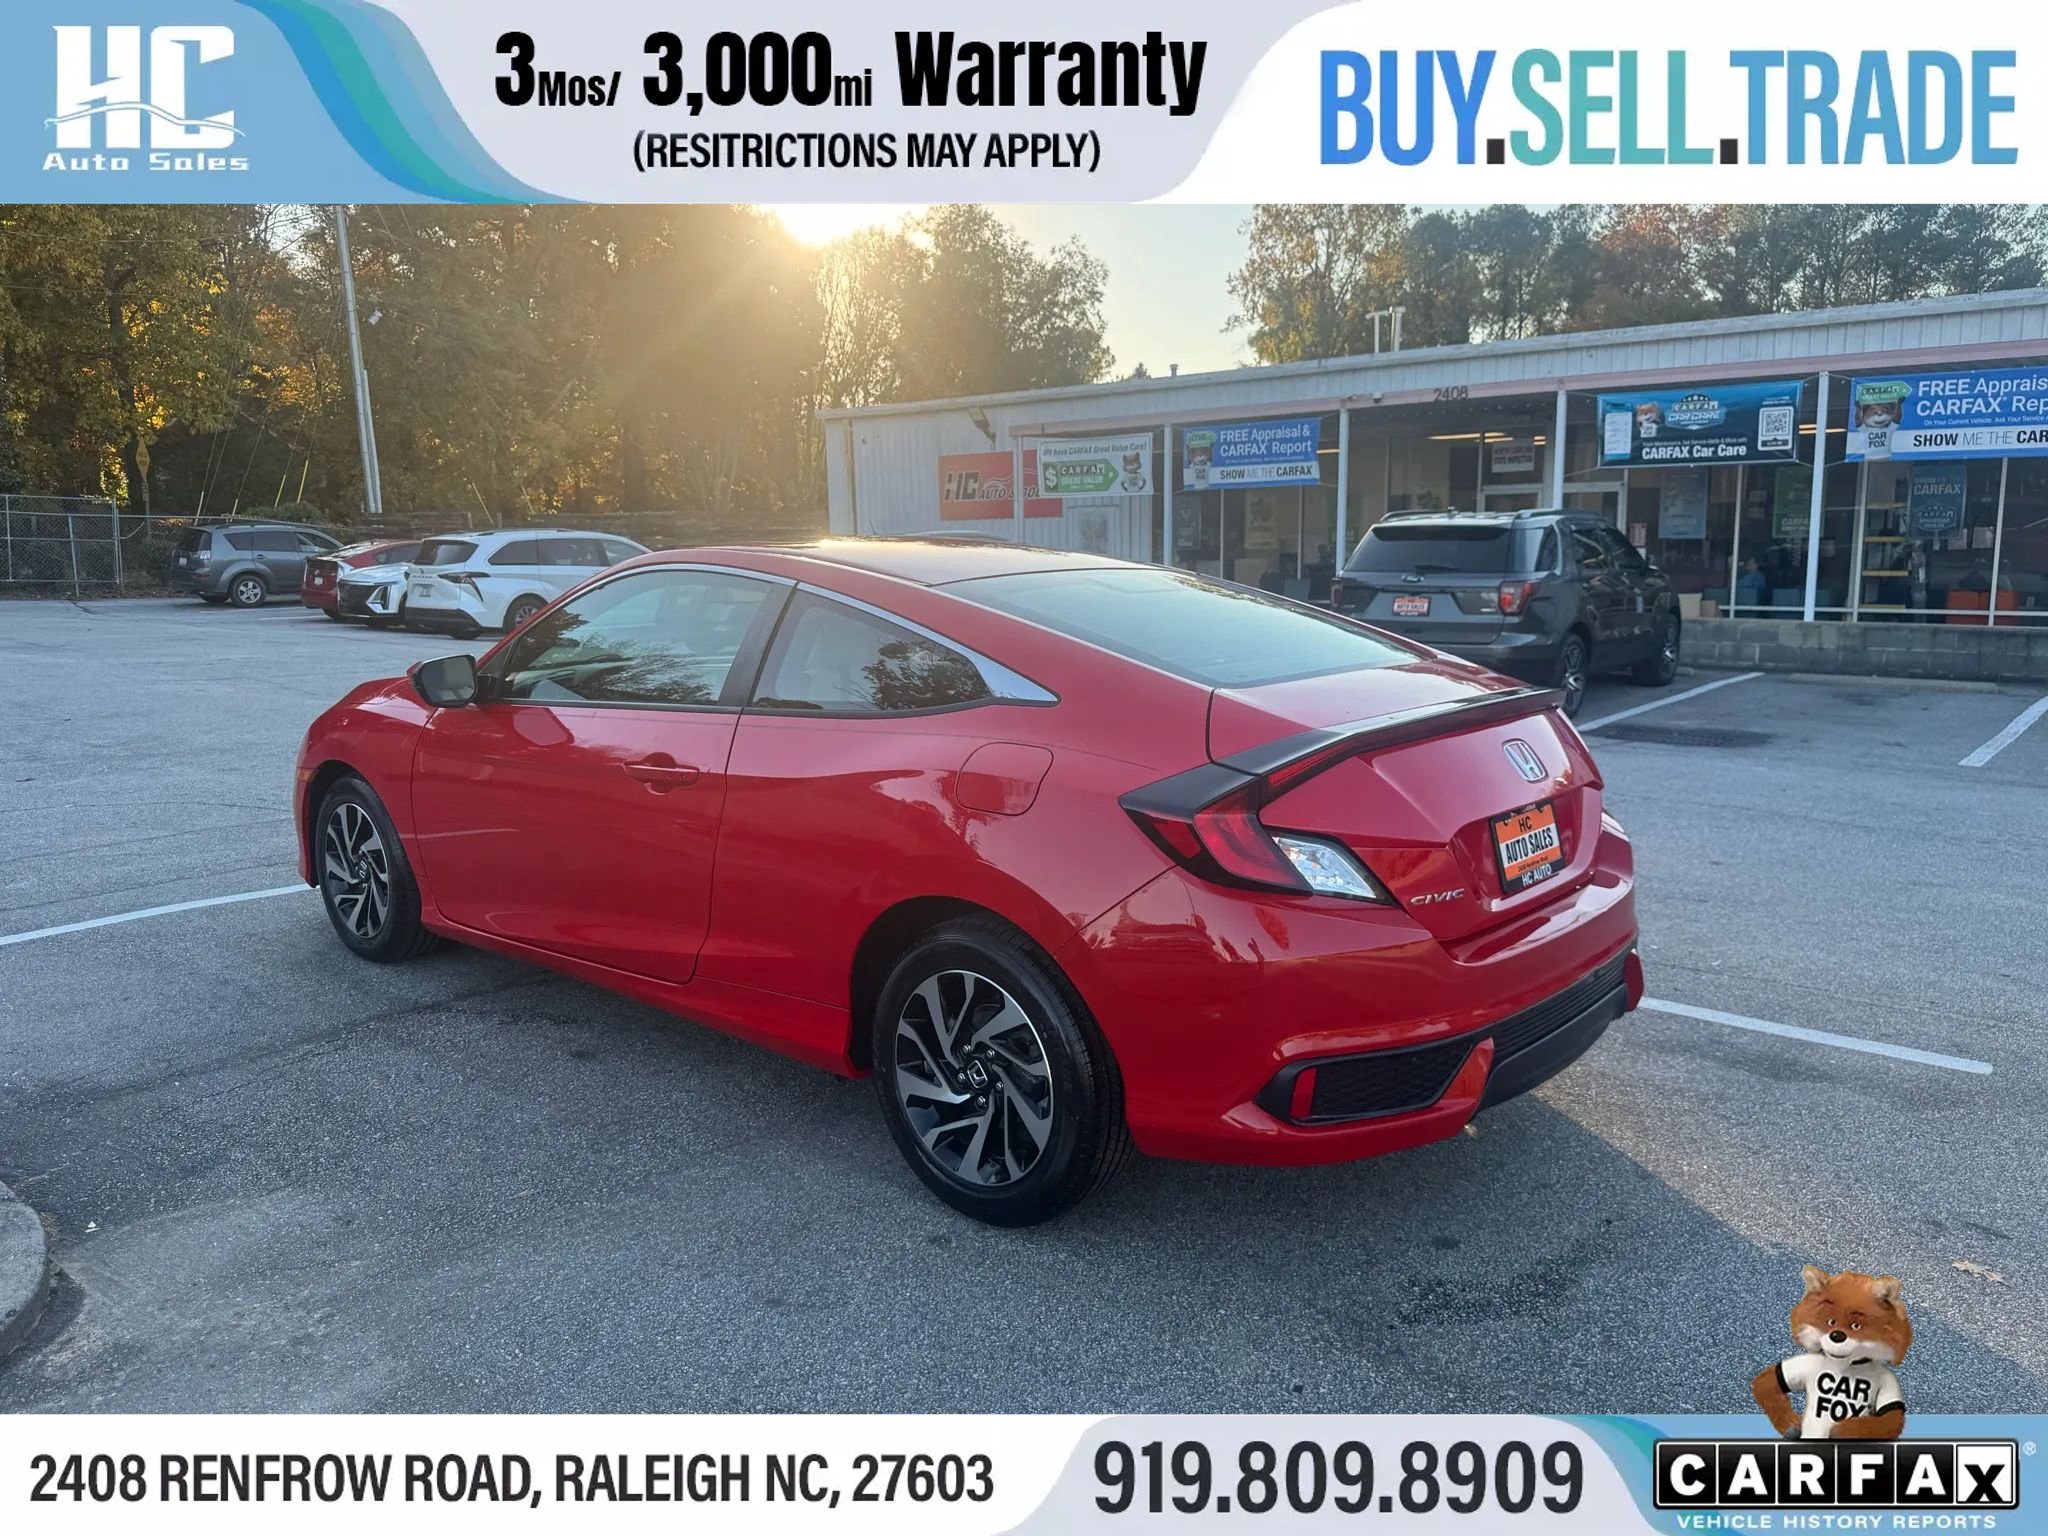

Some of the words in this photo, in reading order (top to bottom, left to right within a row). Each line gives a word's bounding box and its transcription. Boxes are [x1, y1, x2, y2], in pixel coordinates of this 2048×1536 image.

[1433, 385, 1469, 401] 2408
[1918, 379, 1970, 397] FREE
[1974, 374, 2048, 396] Apprais
[2012, 396, 2048, 415] Rep
[1220, 429, 1249, 442] FREE
[1251, 424, 1301, 444] Appraisal
[1302, 424, 1310, 437] &
[1868, 432, 1887, 441] CAR
[1913, 433, 1958, 447] SHOW
[1962, 431, 1984, 446] ME
[1987, 430, 2013, 445] THE
[2016, 430, 2048, 444] CAR
[1220, 442, 1267, 456] CARFAX
[1272, 440, 1311, 456] Report
[1642, 445, 1689, 460] CARFAX
[1693, 445, 1715, 457] Car
[1717, 444, 1747, 456] Care
[1868, 440, 1886, 449] FOX
[1220, 470, 1245, 480] SHOW
[1276, 465, 1313, 476] CARFAX
[944, 472, 979, 500] HC
[979, 487, 1006, 499] AUTO
[1913, 484, 1960, 496] CARFAX
[1518, 815, 1532, 833] HC
[1505, 837, 1529, 865] AUTO
[1528, 827, 1554, 854] SALES
[1521, 872, 1533, 887] HC
[1533, 863, 1552, 882] AUTO
[1410, 888, 1465, 906] CIVIC
